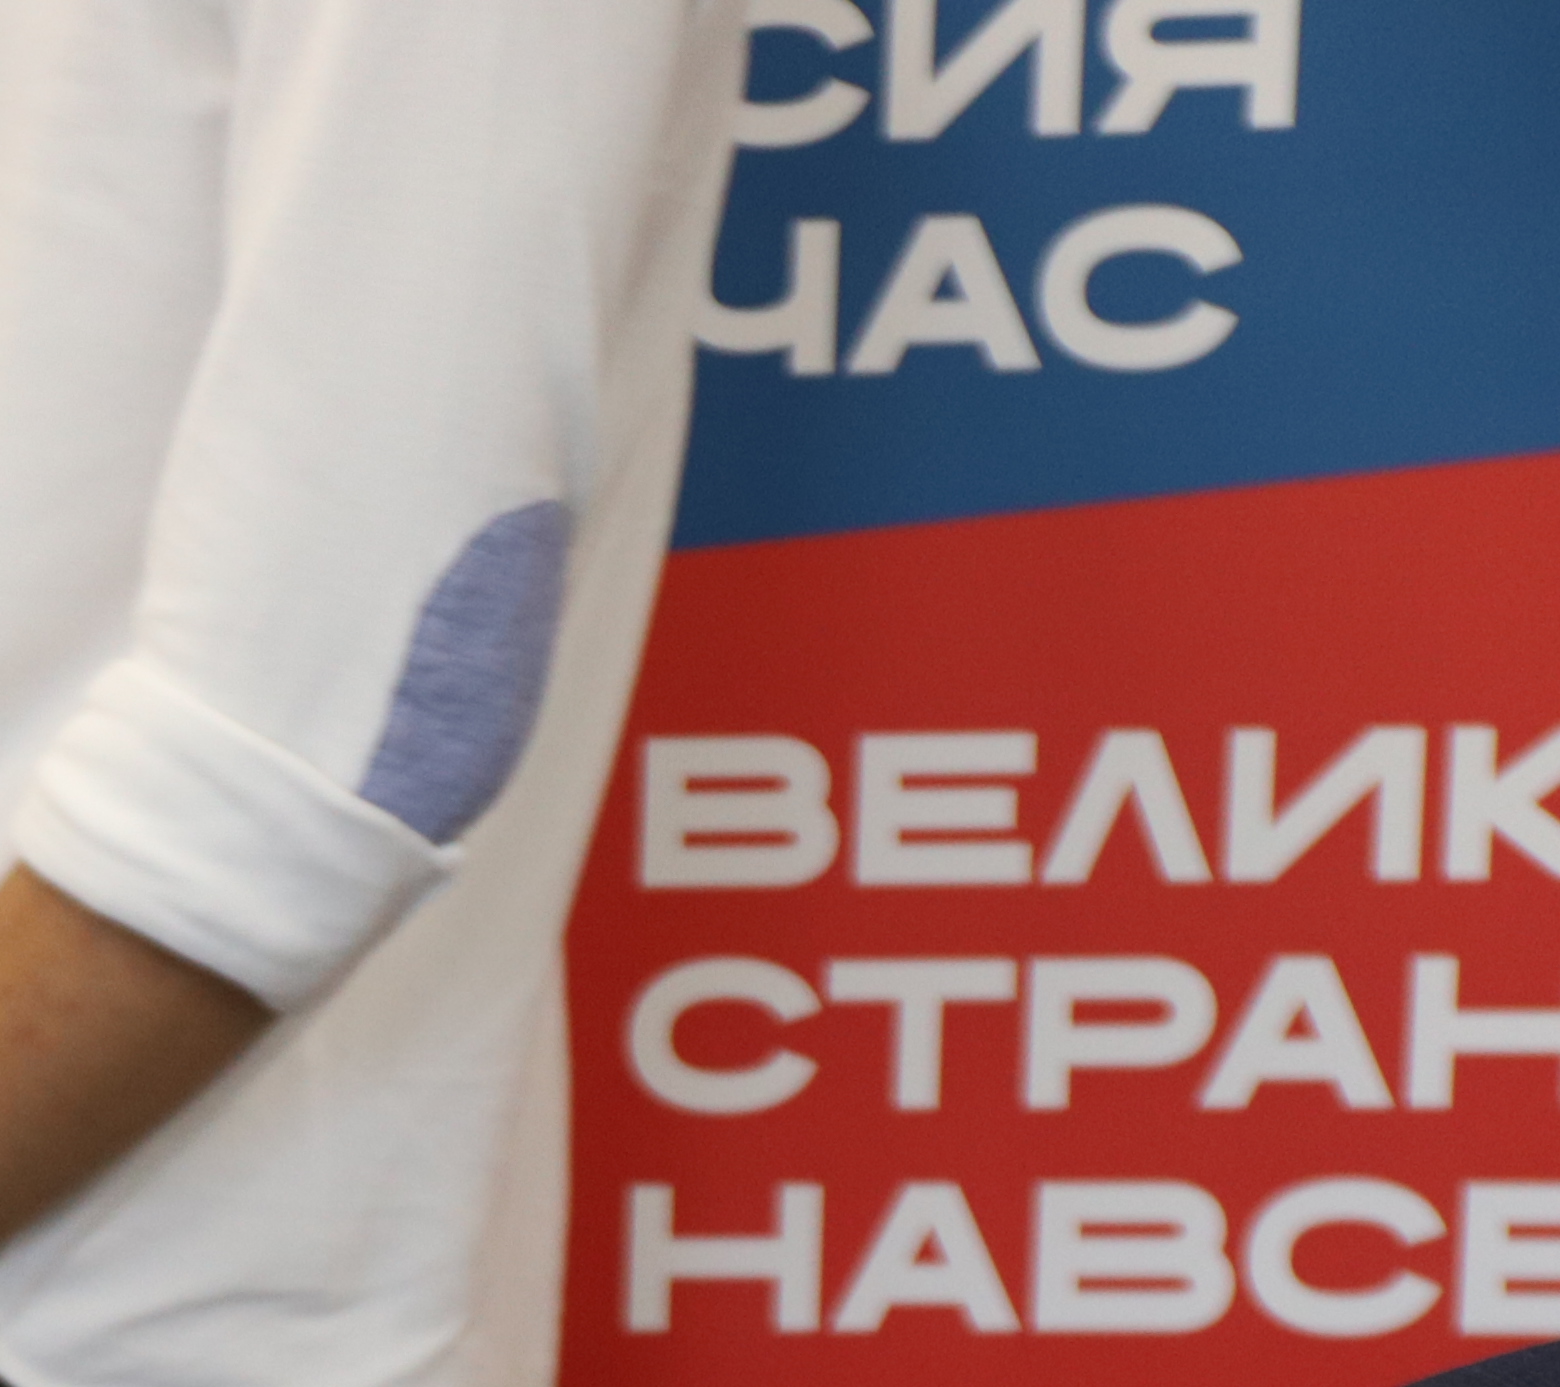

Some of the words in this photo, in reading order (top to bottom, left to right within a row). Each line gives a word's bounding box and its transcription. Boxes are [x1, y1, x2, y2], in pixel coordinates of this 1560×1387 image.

[692, 205, 1244, 376] ЧАС
[637, 725, 1560, 890] ВЕЛИК
[625, 954, 1560, 1115] СТРАН
[623, 1174, 1560, 1339] НАВСЕ
